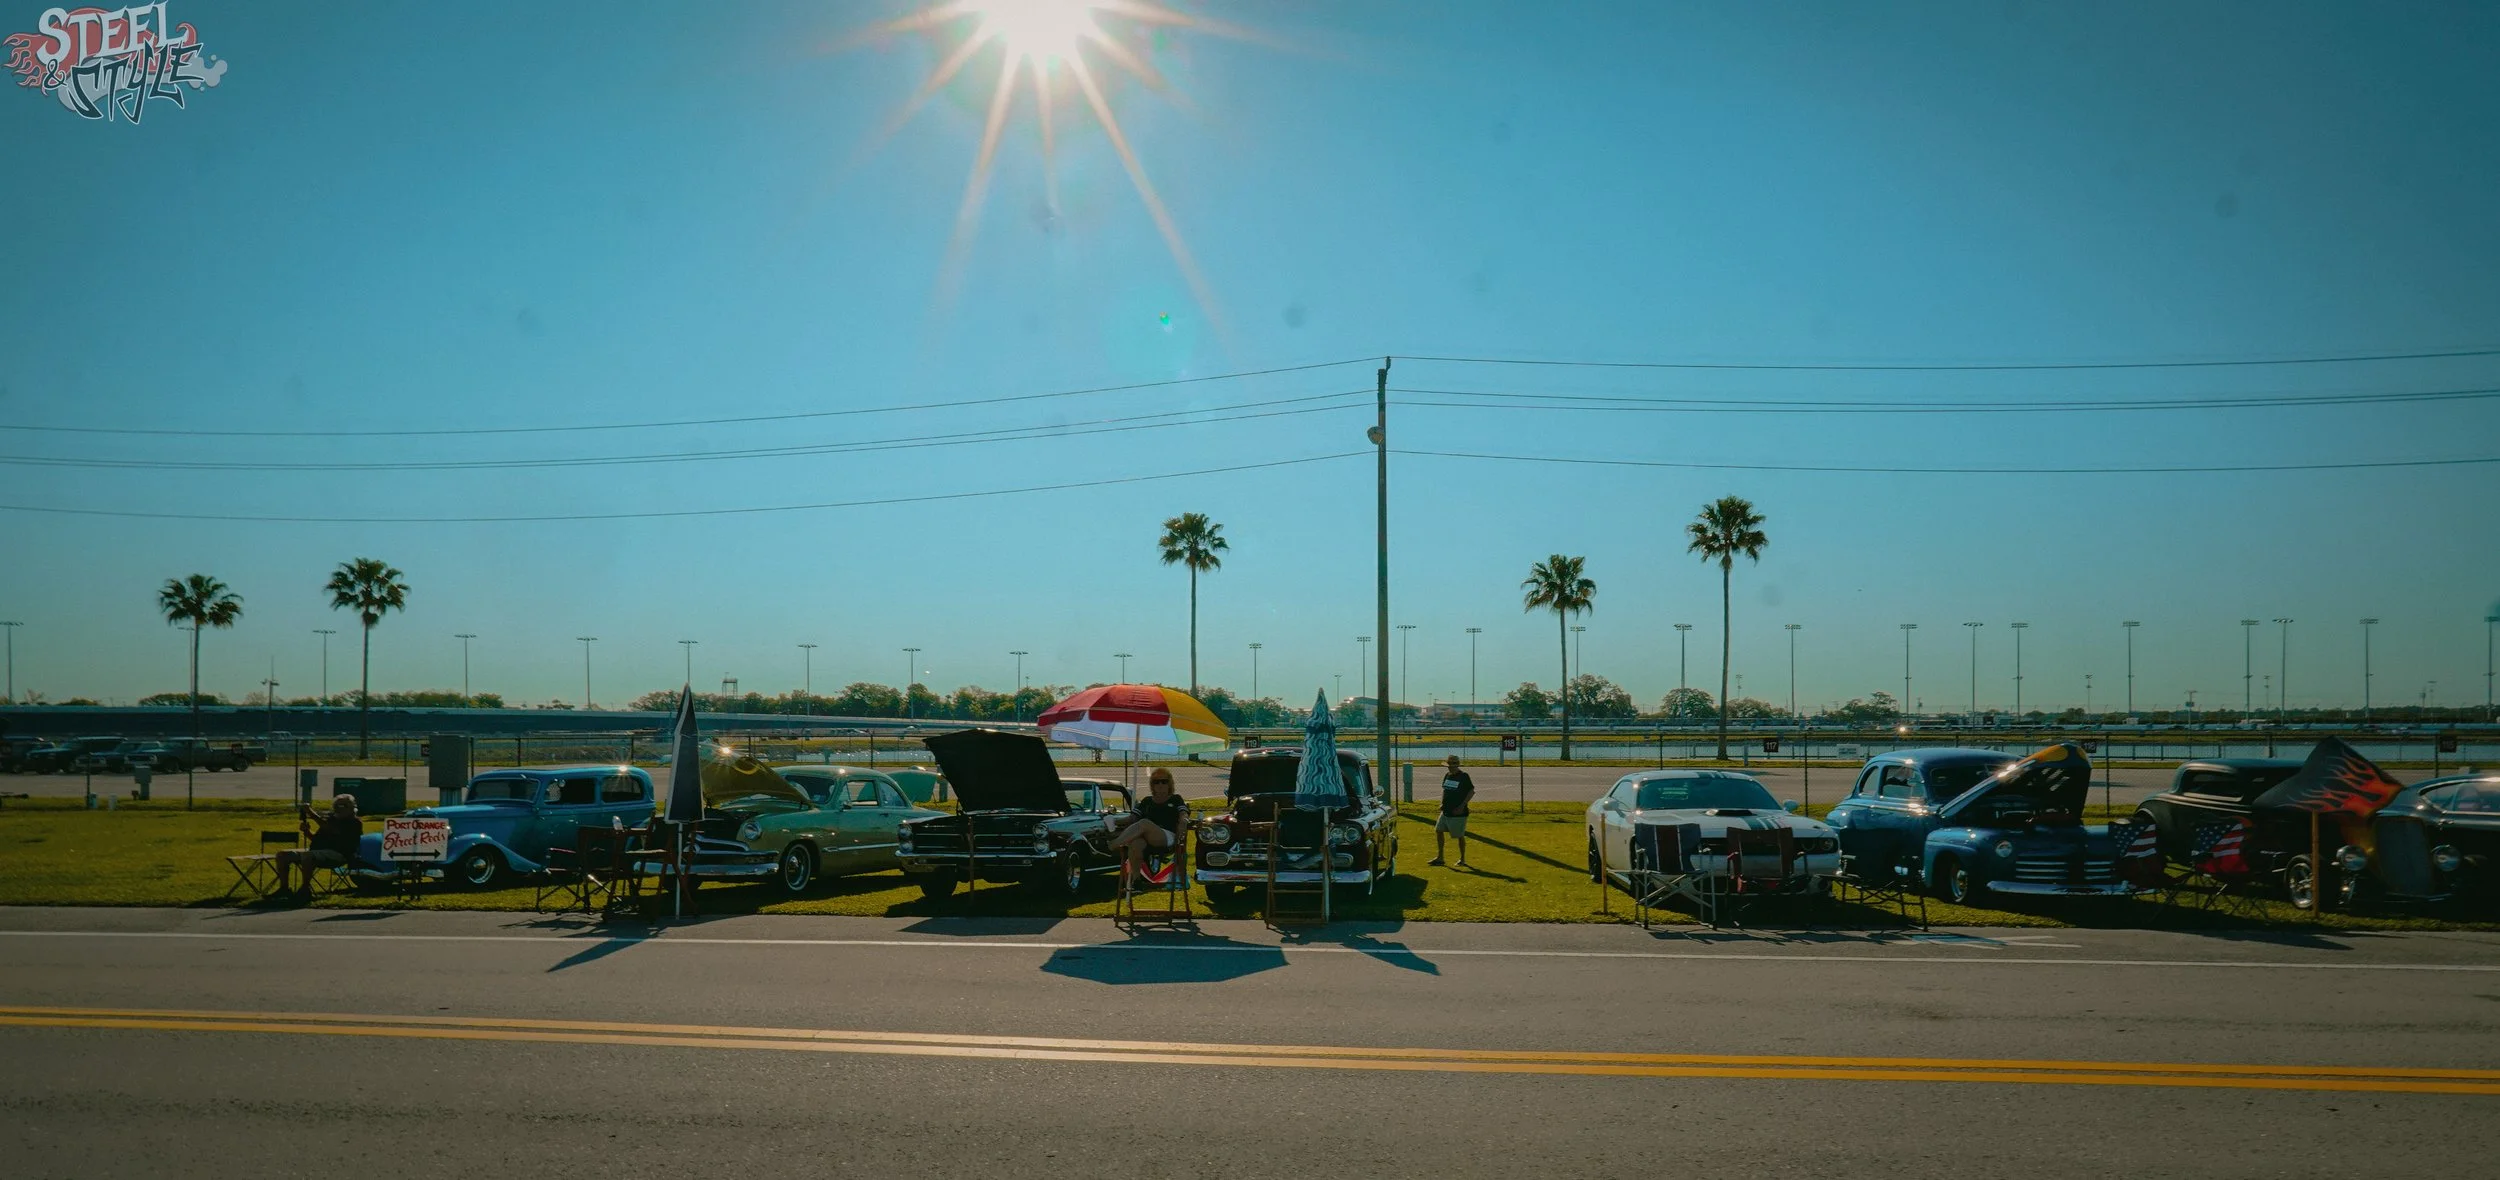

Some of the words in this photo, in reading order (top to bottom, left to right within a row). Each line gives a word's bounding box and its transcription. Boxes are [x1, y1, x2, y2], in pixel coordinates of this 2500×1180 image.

[1246, 739, 1257, 748] 119
[1504, 738, 1515, 748] 118
[1766, 741, 1777, 750] 117
[412, 820, 446, 830] ORANGE
[384, 832, 417, 850] Street
